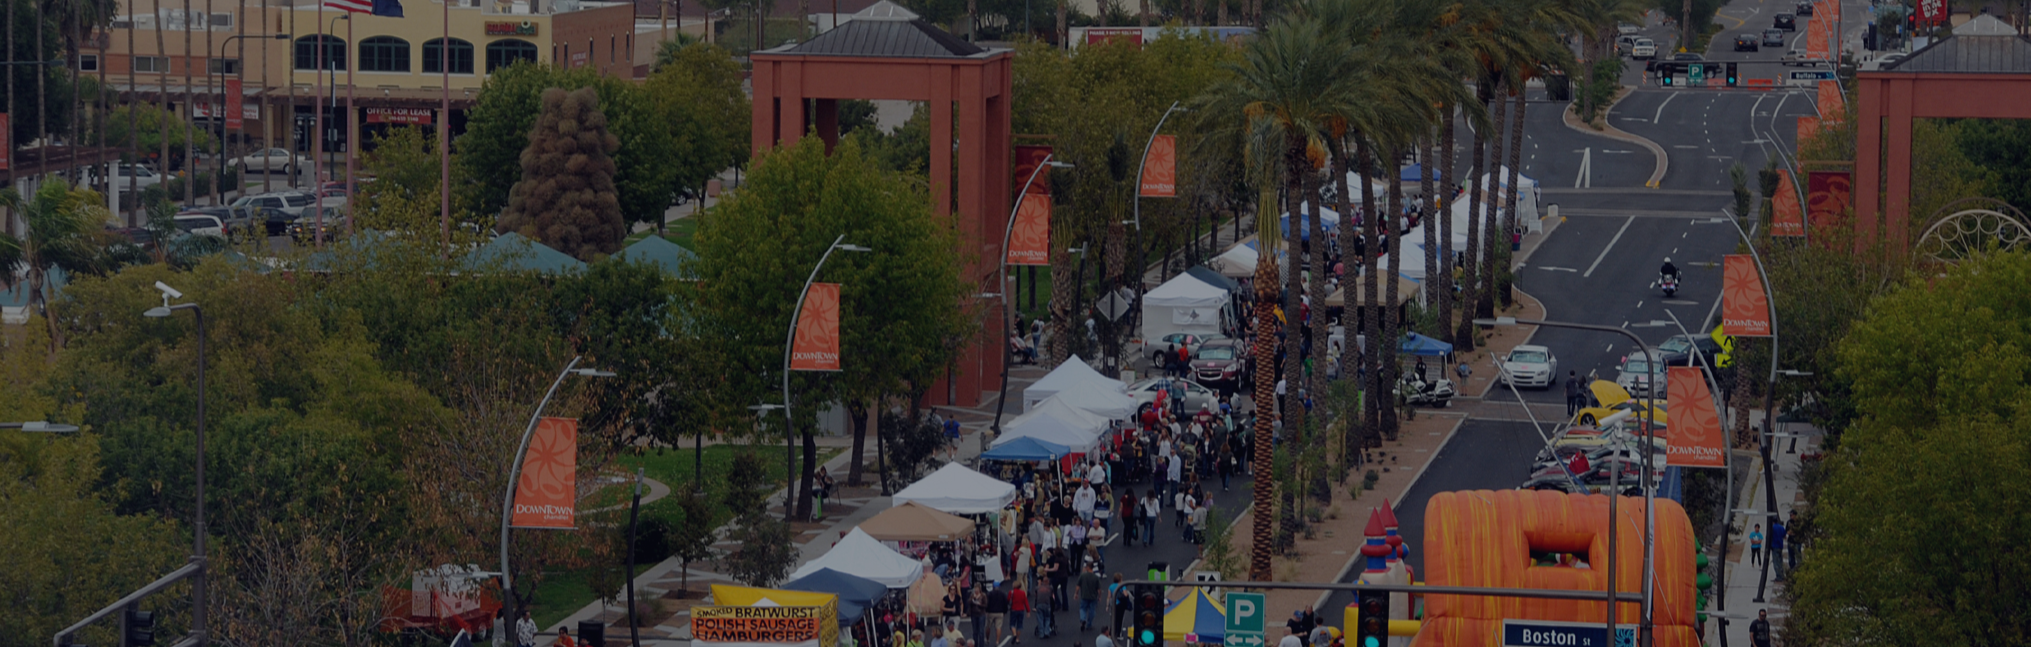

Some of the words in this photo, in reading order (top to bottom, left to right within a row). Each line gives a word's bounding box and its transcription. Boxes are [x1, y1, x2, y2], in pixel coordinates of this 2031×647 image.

[1691, 66, 1700, 77] P
[366, 107, 391, 115] OFFICE
[393, 108, 409, 116] FOR
[410, 108, 431, 117] LEASE
[1009, 250, 1047, 258] DOWNTOWN
[1723, 319, 1768, 328] DOWNTOWN
[793, 351, 838, 360] DOWNTOWN
[1667, 444, 1722, 456] DOWNTOWN
[516, 504, 573, 516] DOWNTOWN
[697, 607, 733, 618] SMOKED
[735, 606, 815, 618] BRATWURST
[1234, 599, 1256, 626] P
[696, 618, 746, 631] POLISH
[750, 618, 815, 631] SAUSAGE
[696, 630, 813, 641] HAMBURGERS
[1522, 628, 1577, 646] Boston
